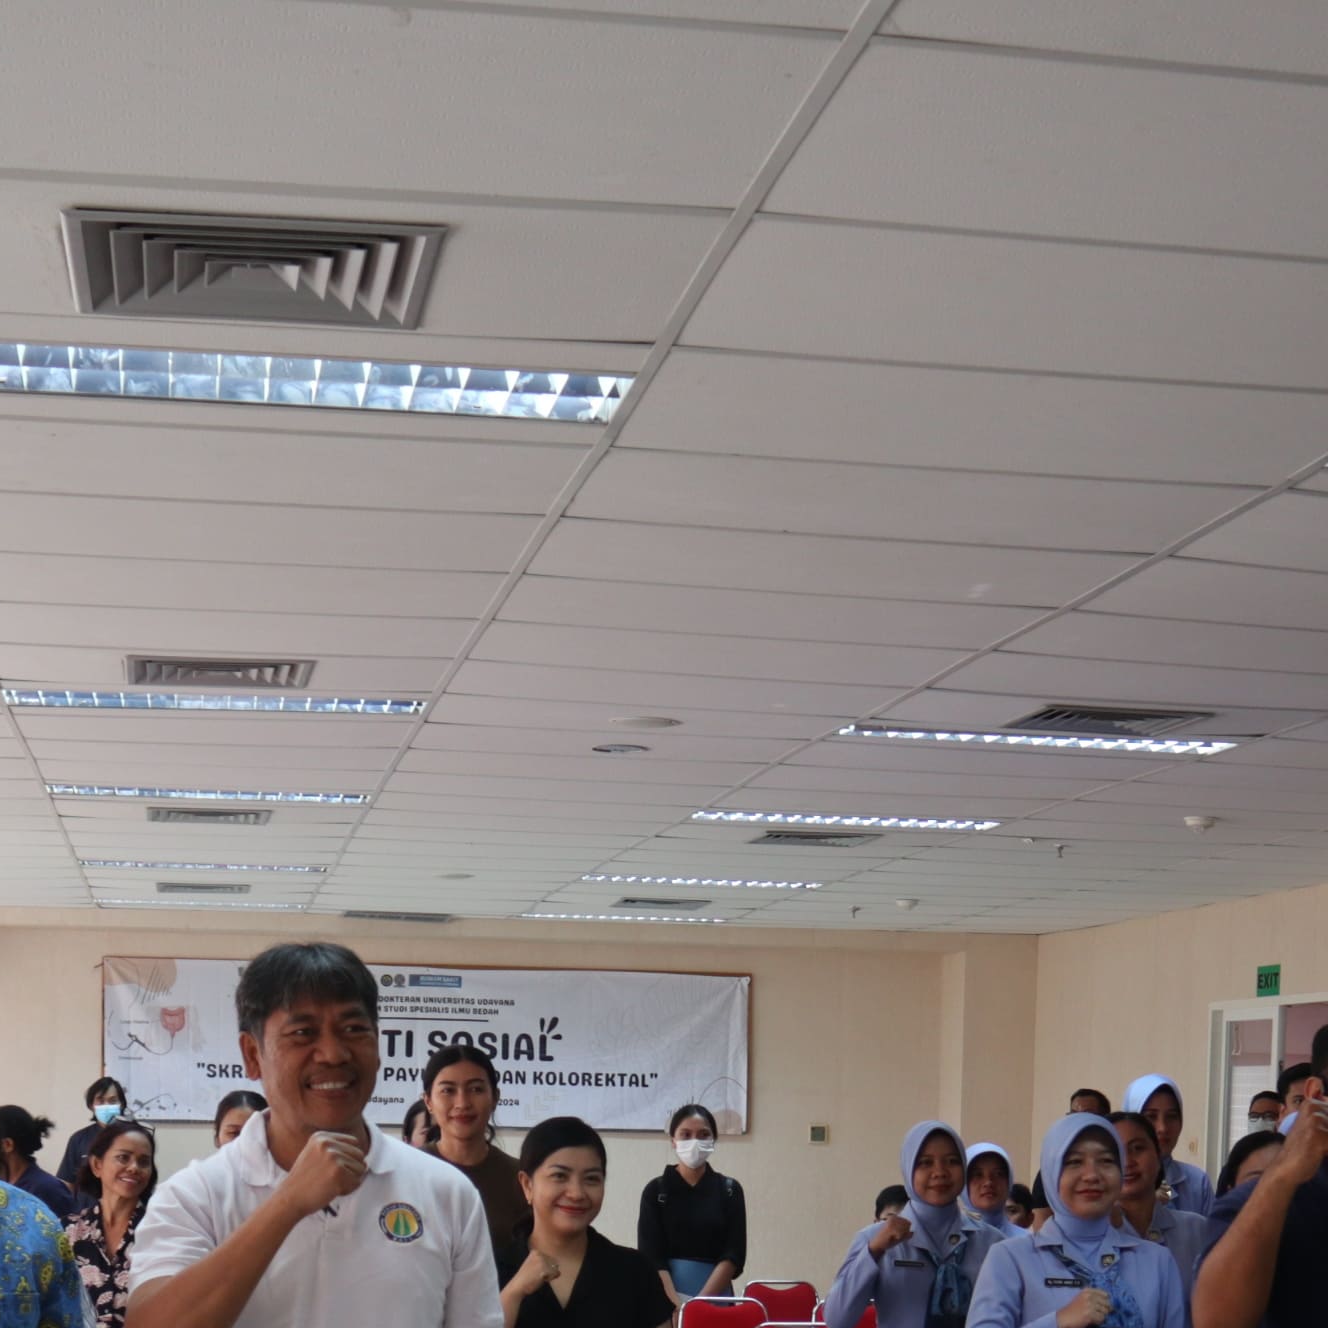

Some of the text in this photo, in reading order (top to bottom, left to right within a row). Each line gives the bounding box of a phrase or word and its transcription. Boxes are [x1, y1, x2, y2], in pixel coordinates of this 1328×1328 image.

[1257, 972, 1279, 989] EXIT
[378, 995, 421, 1003] DOKTERAN
[423, 997, 475, 1005] UNIVERSITAS
[384, 1005, 407, 1013] STUDI
[410, 1006, 449, 1014] SPESIALIS
[381, 1030, 413, 1057] TI
[197, 1063, 247, 1078] "SKR
[384, 1067, 425, 1082] PAY
[533, 1071, 658, 1087] KOLOREKTAL"
[369, 1096, 519, 1106] dayana 2024
